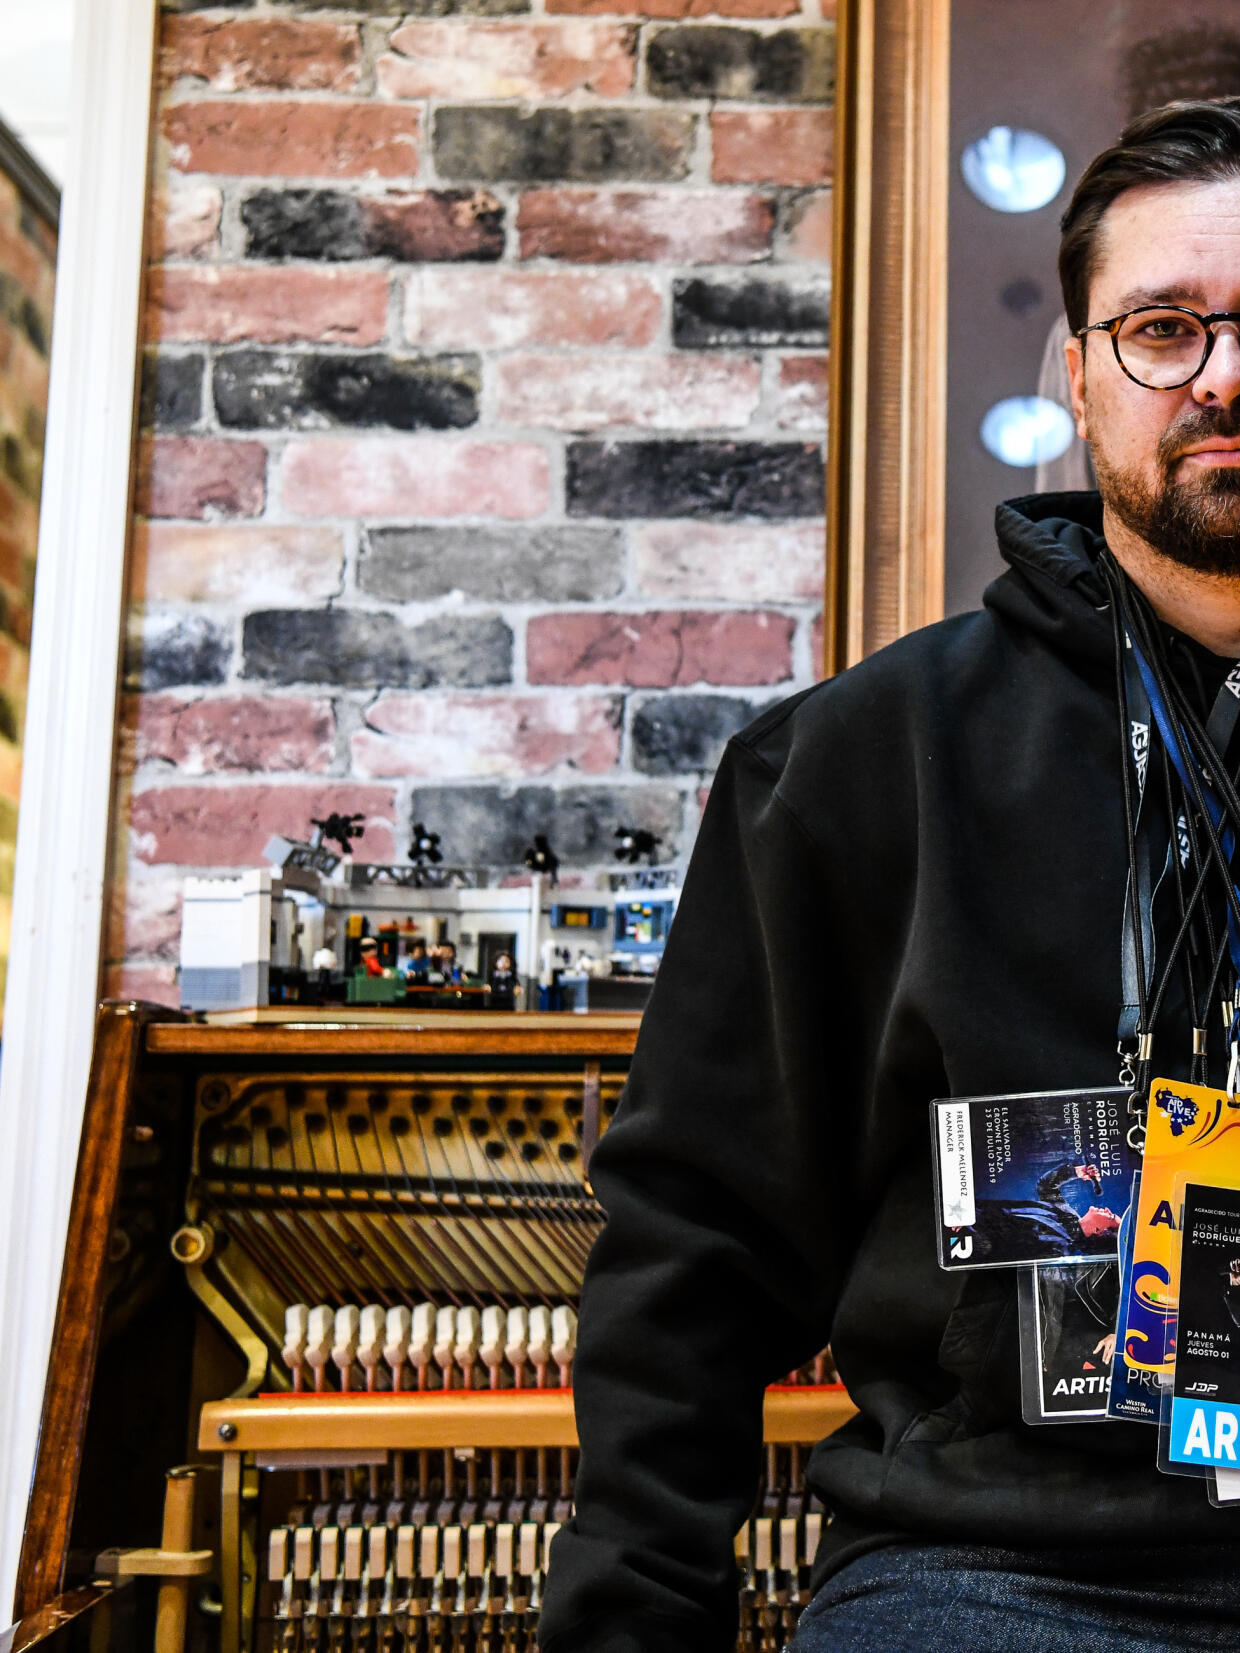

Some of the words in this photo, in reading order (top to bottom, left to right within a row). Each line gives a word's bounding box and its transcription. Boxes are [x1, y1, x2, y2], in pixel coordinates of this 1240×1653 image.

[985, 1108, 992, 1119] 25
[1002, 1107, 1008, 1117] EL
[1063, 1103, 1071, 1124] TOUR
[1107, 1100, 1120, 1136] JOSÉ
[1166, 1104, 1191, 1116] LIVE
[945, 1111, 954, 1153] MANAGER
[956, 1110, 966, 1152] FREDERICK
[986, 1122, 993, 1133] DE
[993, 1107, 1002, 1142] CROWNE
[1071, 1102, 1082, 1155] AGRADECIDO
[987, 1134, 995, 1160] JULIO
[1002, 1118, 1011, 1163] SALVADOR
[1096, 1100, 1111, 1177] RODRÍGUEZ
[995, 1144, 1004, 1174] PLAZA
[1111, 1143, 1122, 1176] LUIS
[988, 1162, 997, 1184] 2019
[1193, 1222, 1219, 1233] JOSÉ
[1187, 1330, 1231, 1343] PANAMÁ
[1187, 1340, 1214, 1349] JUEVES
[1187, 1347, 1219, 1358] AGOSTO
